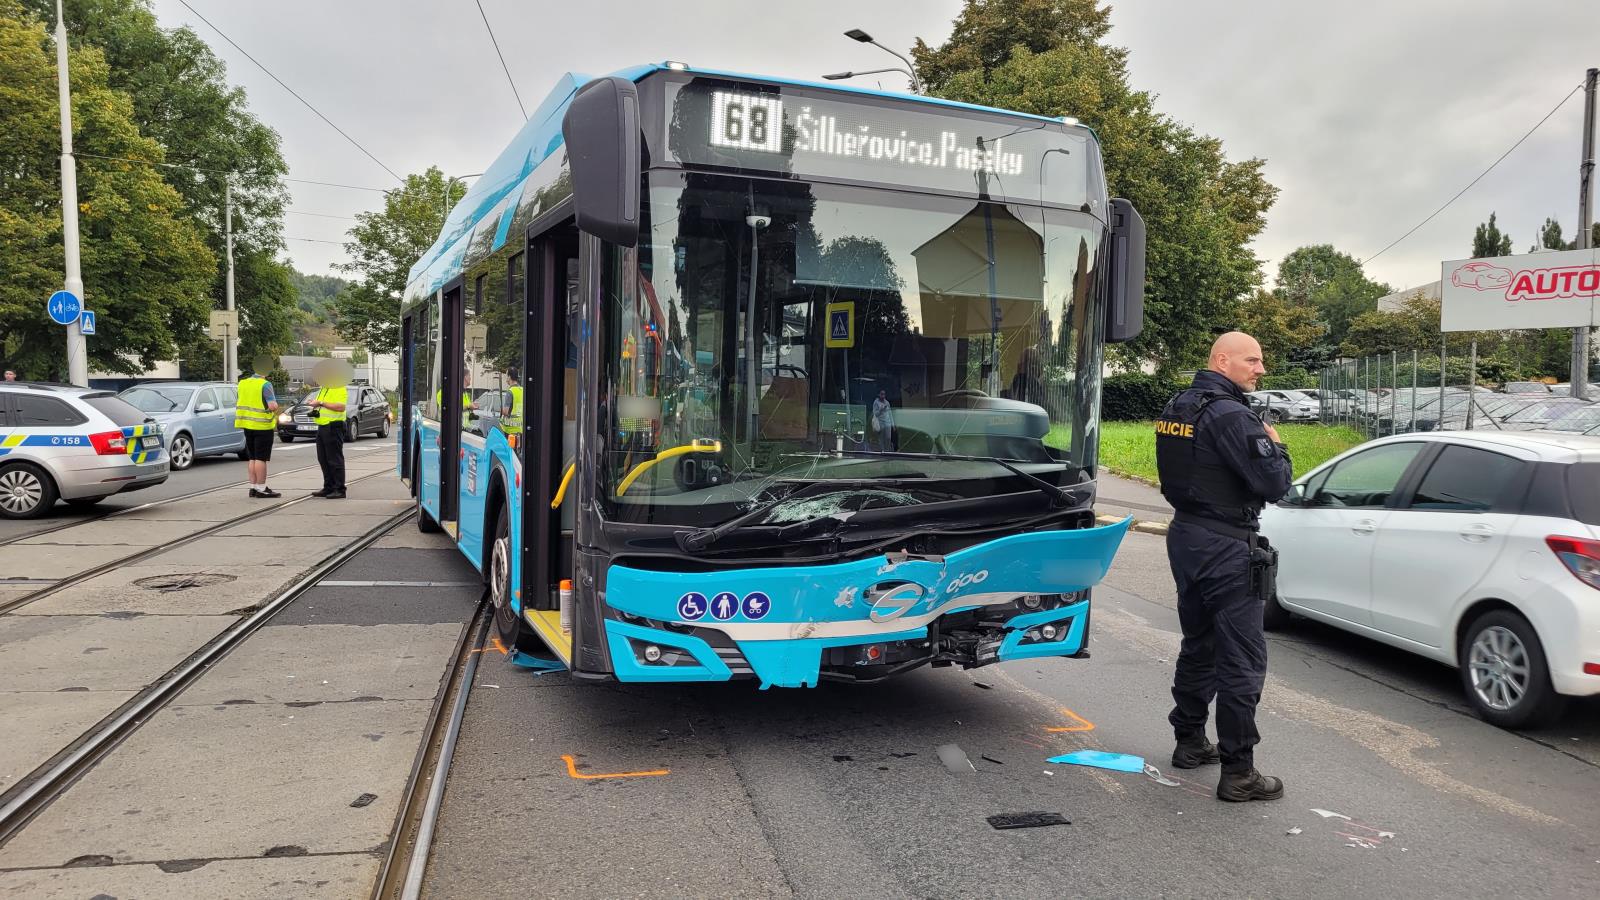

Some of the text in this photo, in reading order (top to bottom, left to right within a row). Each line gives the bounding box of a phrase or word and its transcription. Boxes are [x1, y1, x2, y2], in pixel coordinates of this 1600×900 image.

[725, 102, 768, 144] 68
[1511, 270, 1600, 296] AUTO
[1156, 420, 1195, 438] OLICIE
[62, 436, 81, 445] 158
